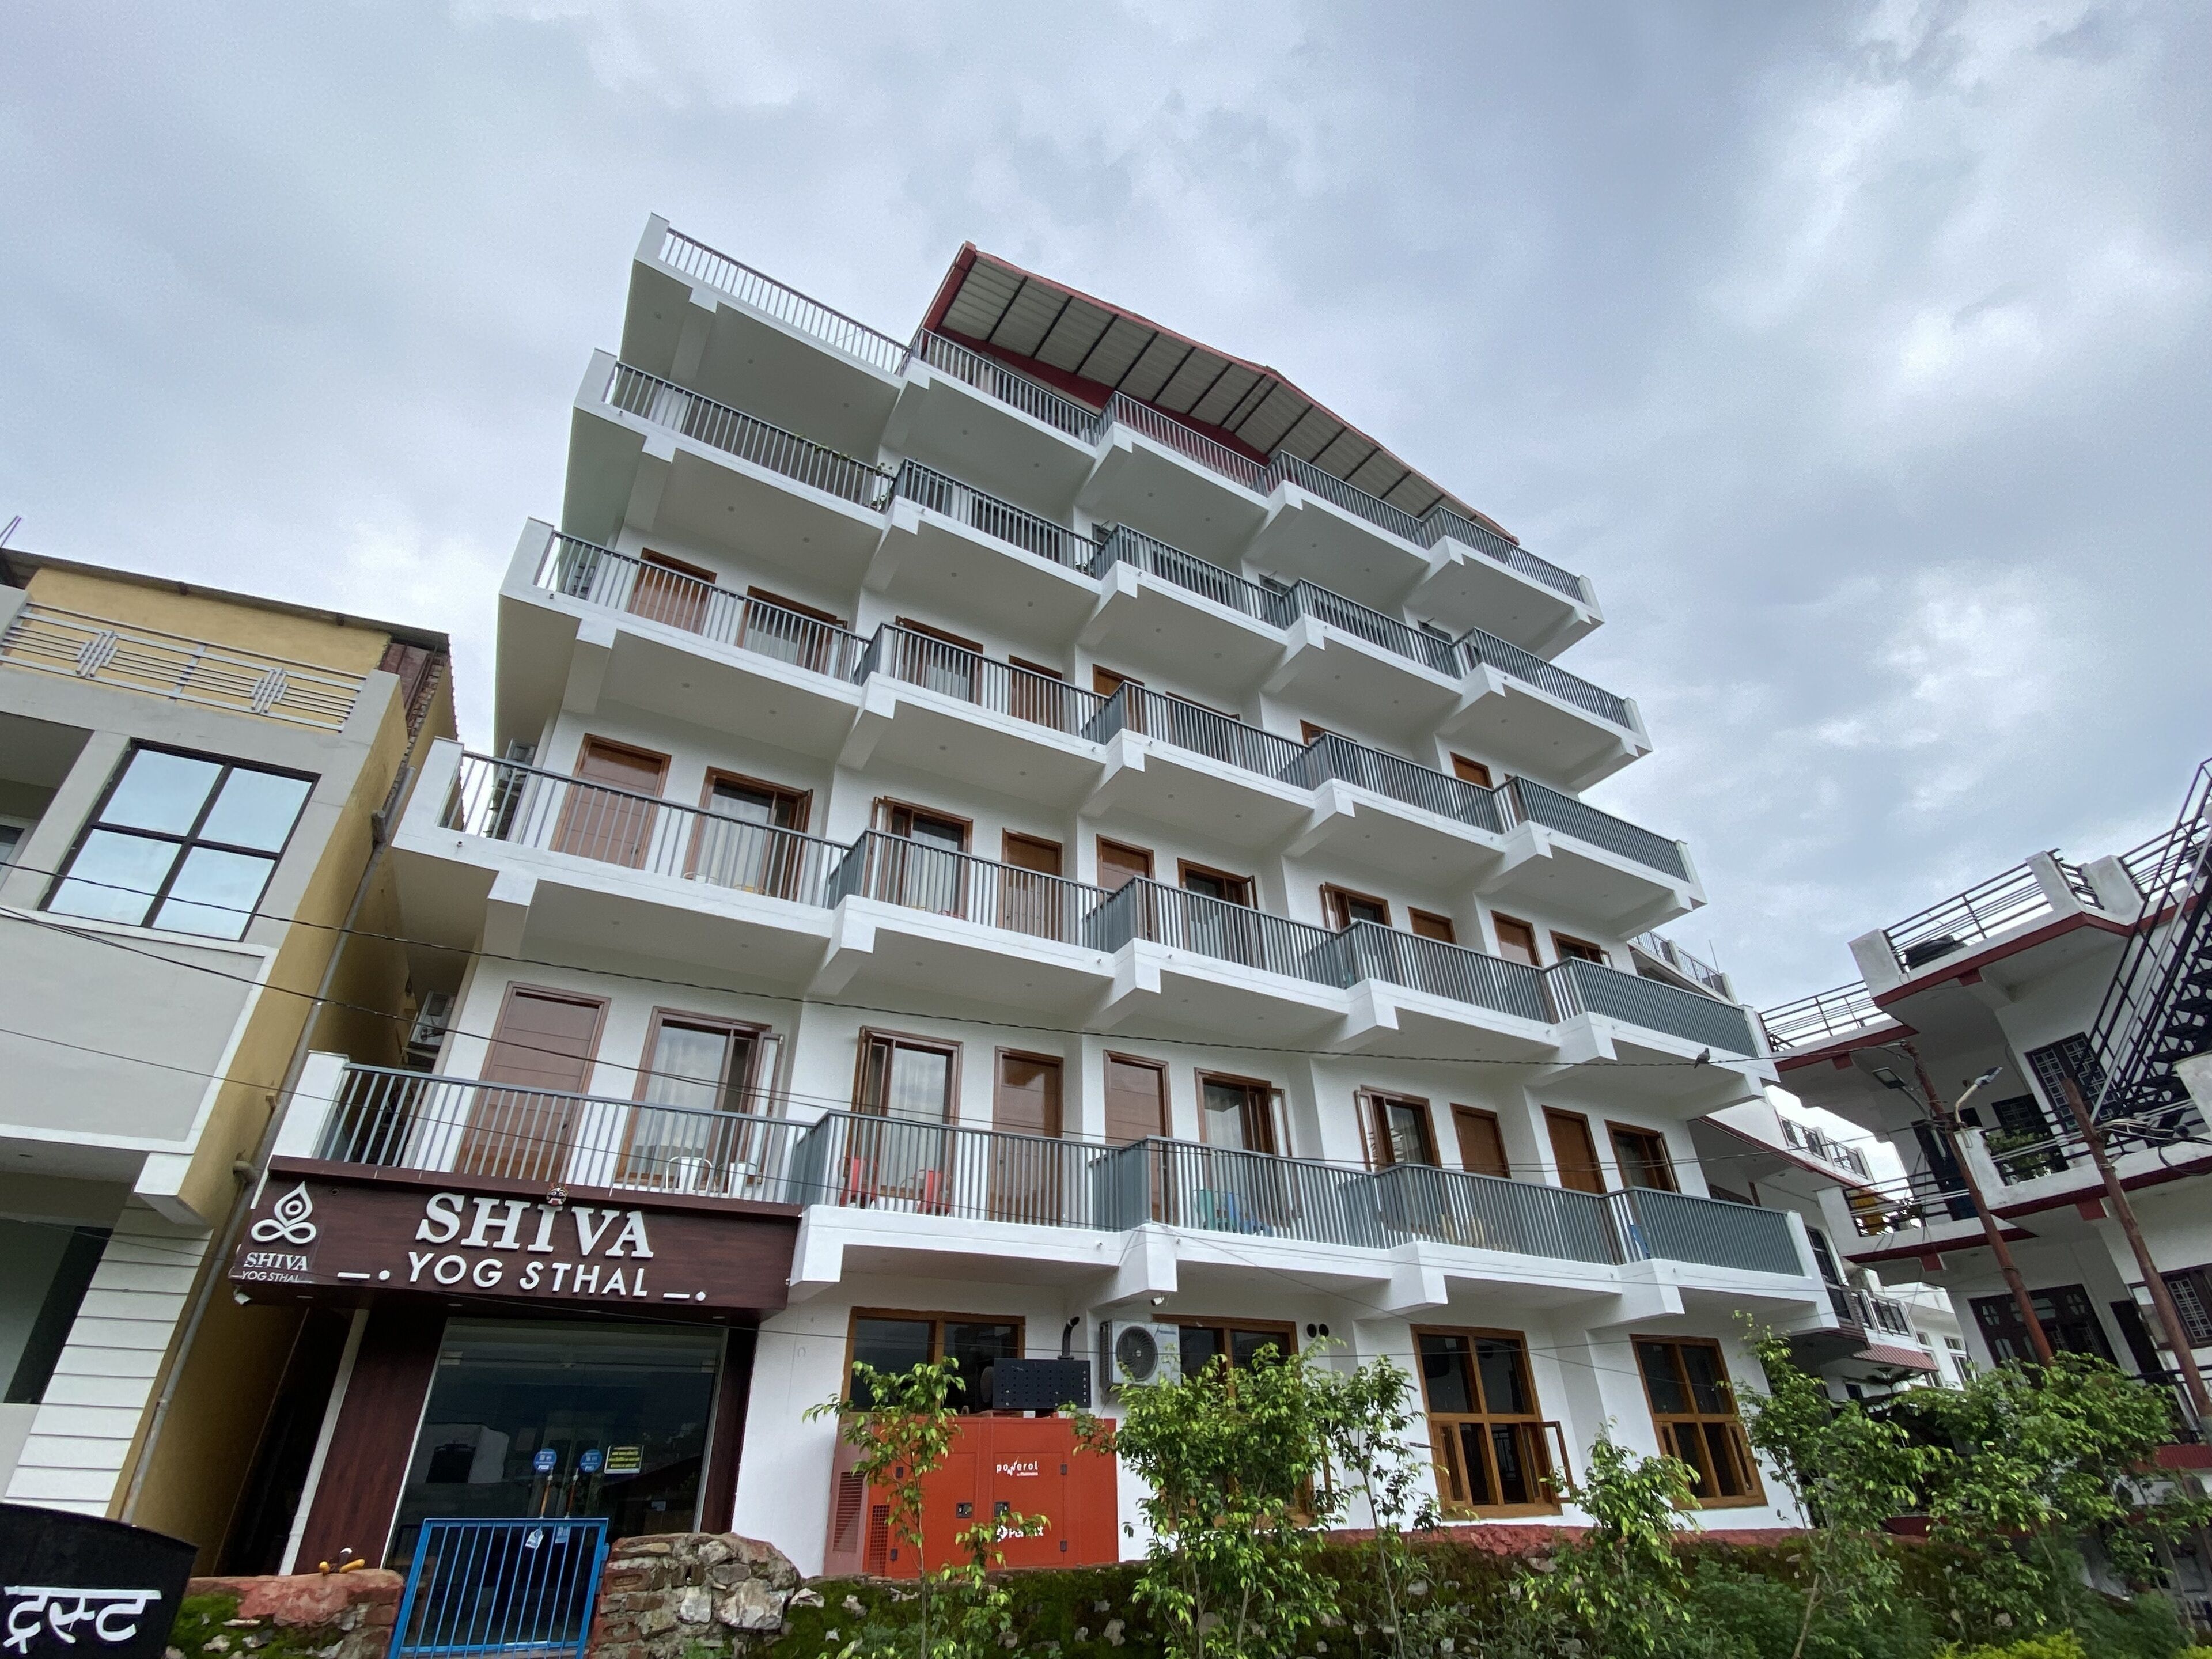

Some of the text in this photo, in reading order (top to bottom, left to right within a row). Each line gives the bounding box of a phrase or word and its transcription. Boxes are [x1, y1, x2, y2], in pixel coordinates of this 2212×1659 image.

[415, 1192, 654, 1258] SHIVA
[241, 1271, 300, 1283] YOG STHAL
[243, 1252, 308, 1271] SHIVA
[408, 1251, 648, 1297] YOG STHAL
